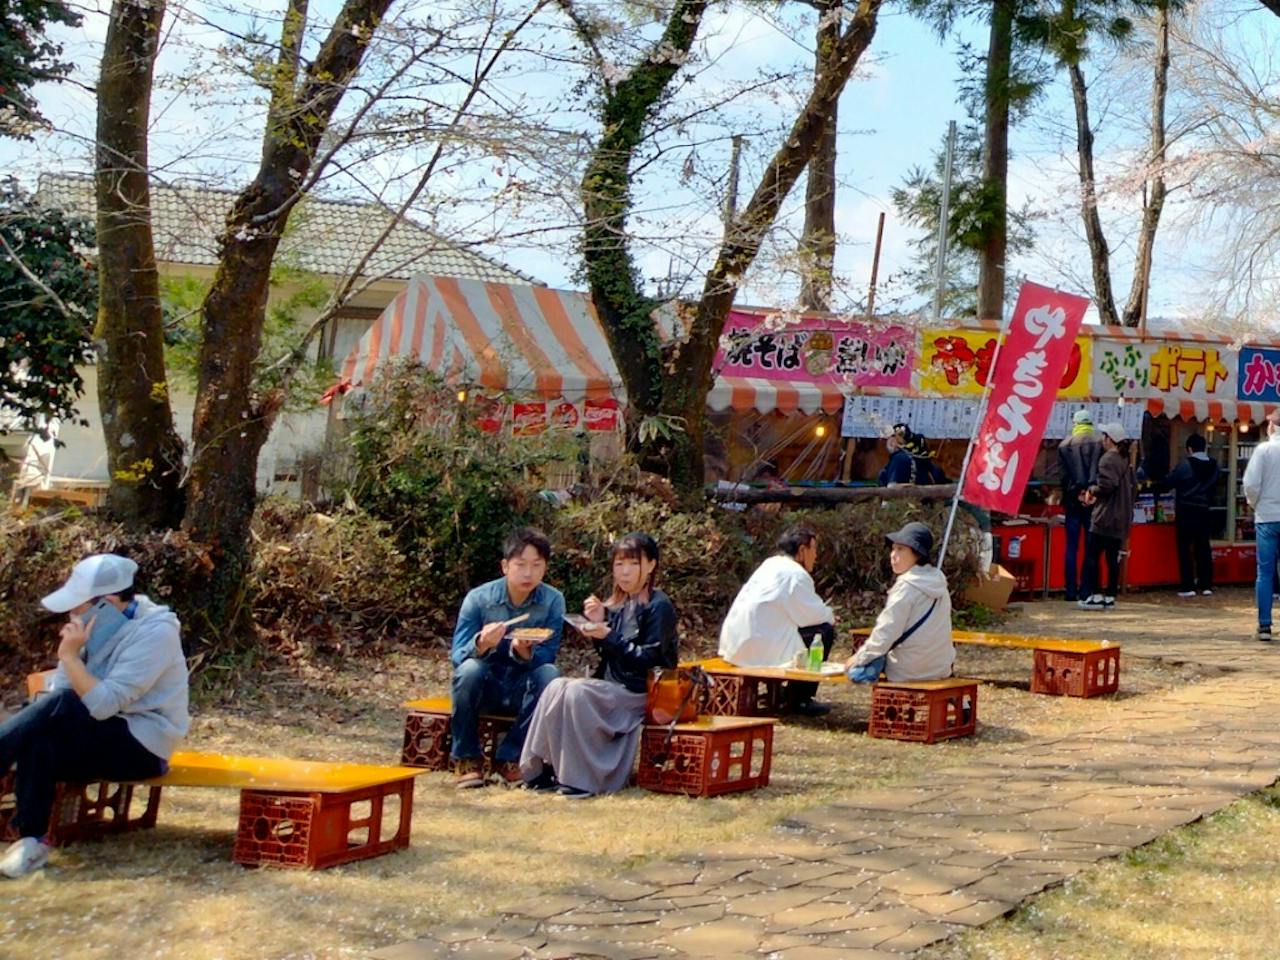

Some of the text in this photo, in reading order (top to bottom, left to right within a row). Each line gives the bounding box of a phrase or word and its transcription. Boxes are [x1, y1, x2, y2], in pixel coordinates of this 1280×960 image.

[977, 304, 1067, 495] やきそば
[1149, 344, 1229, 393] ポテト
